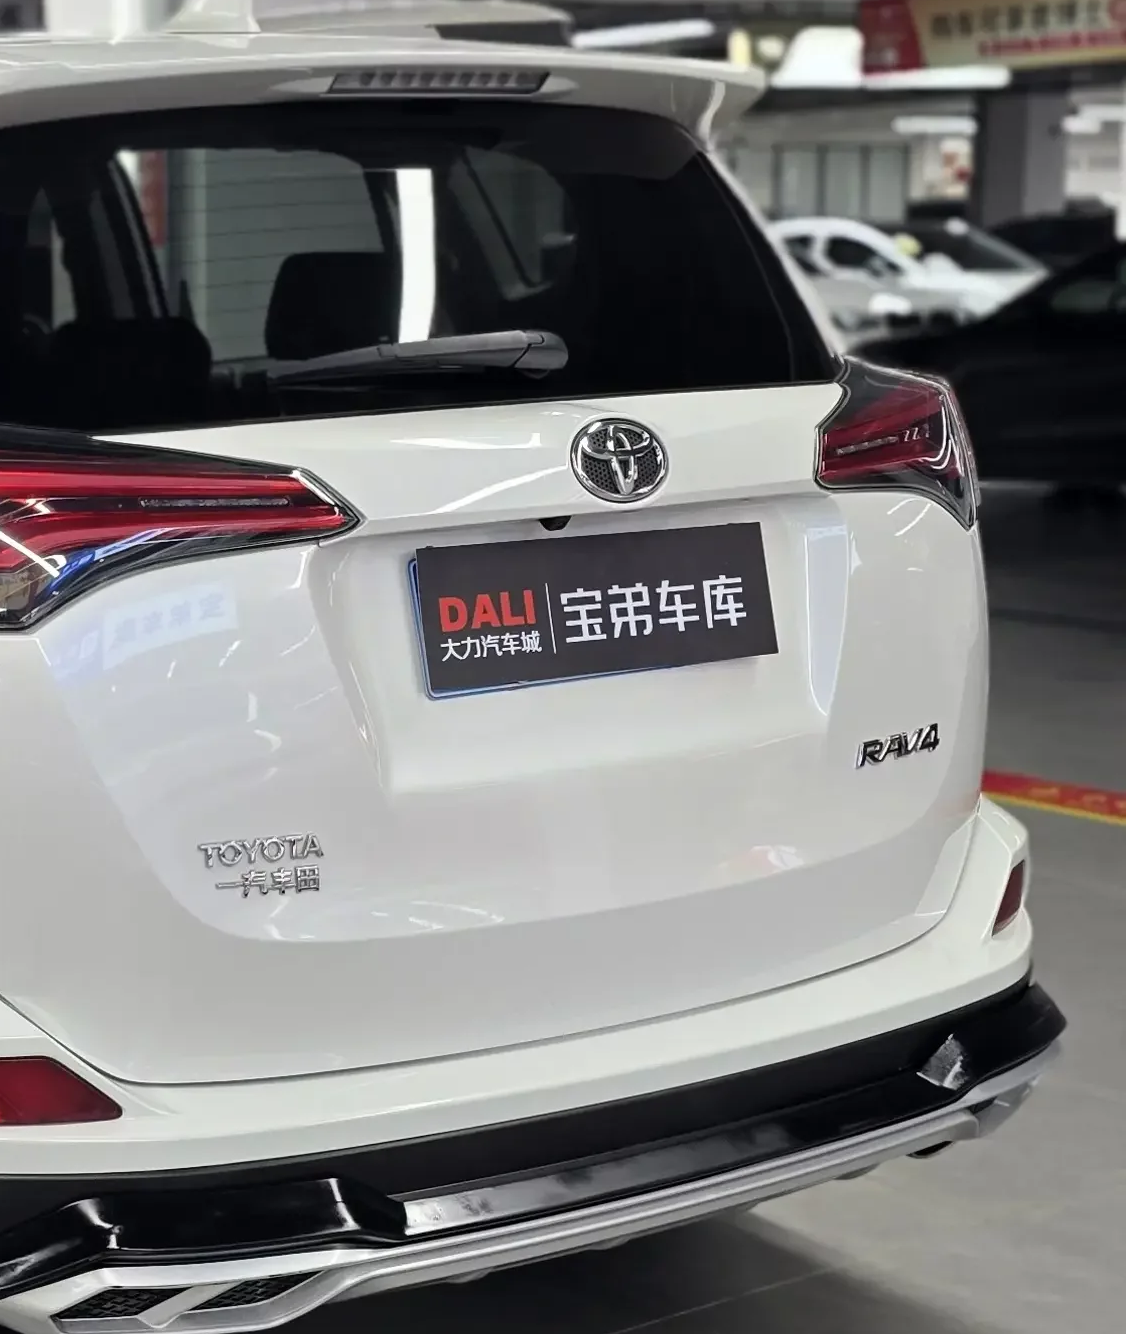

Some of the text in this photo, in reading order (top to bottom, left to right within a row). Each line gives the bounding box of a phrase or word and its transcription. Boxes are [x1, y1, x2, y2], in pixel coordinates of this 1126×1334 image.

[438, 589, 536, 633] DALI
[560, 574, 747, 644] 宝弟车库
[440, 630, 543, 662] 大力汽车城
[855, 722, 941, 769] RAV4
[198, 831, 324, 868] TOYOTA
[215, 864, 320, 898] 一汽丰田
